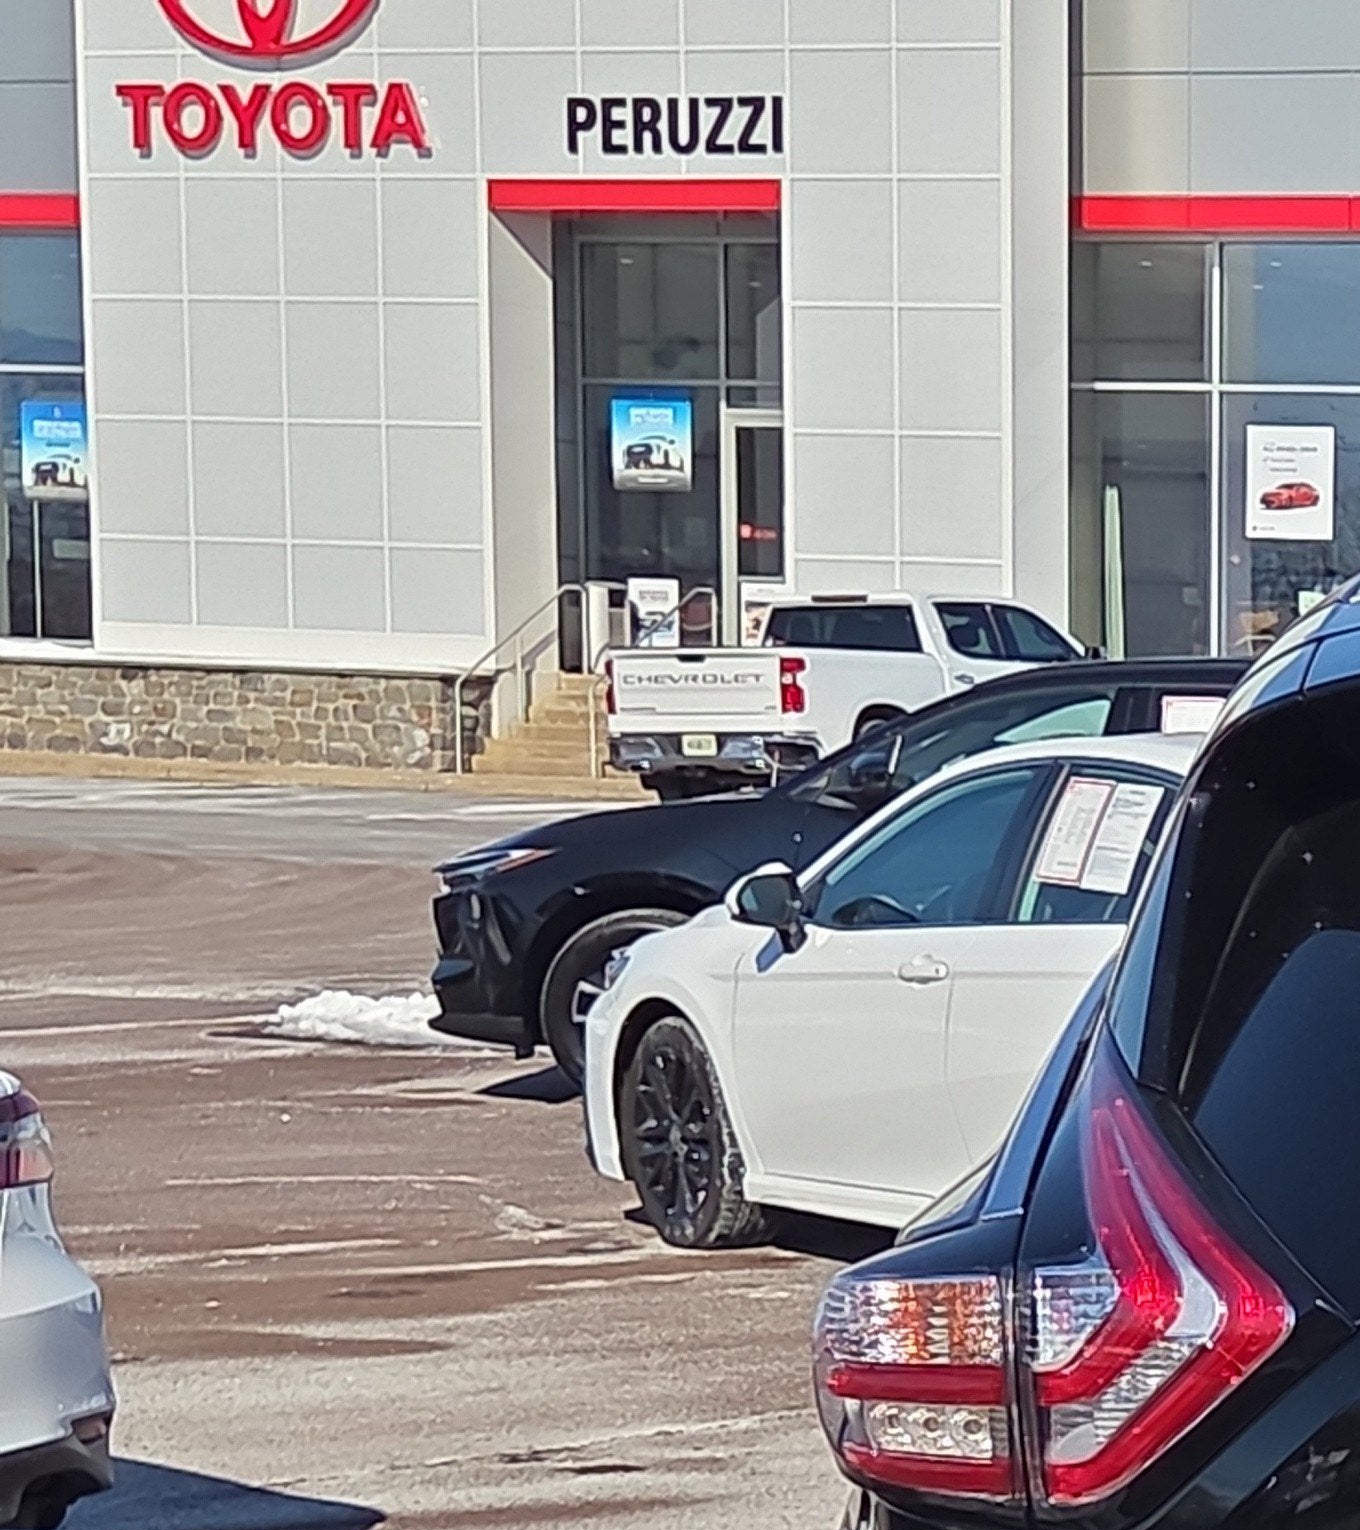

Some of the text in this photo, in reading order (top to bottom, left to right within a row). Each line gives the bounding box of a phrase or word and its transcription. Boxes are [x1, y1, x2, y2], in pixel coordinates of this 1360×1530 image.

[115, 82, 431, 159] TOYOTA
[566, 96, 784, 155] PERUZZI
[622, 673, 764, 685] CHEVROLET
